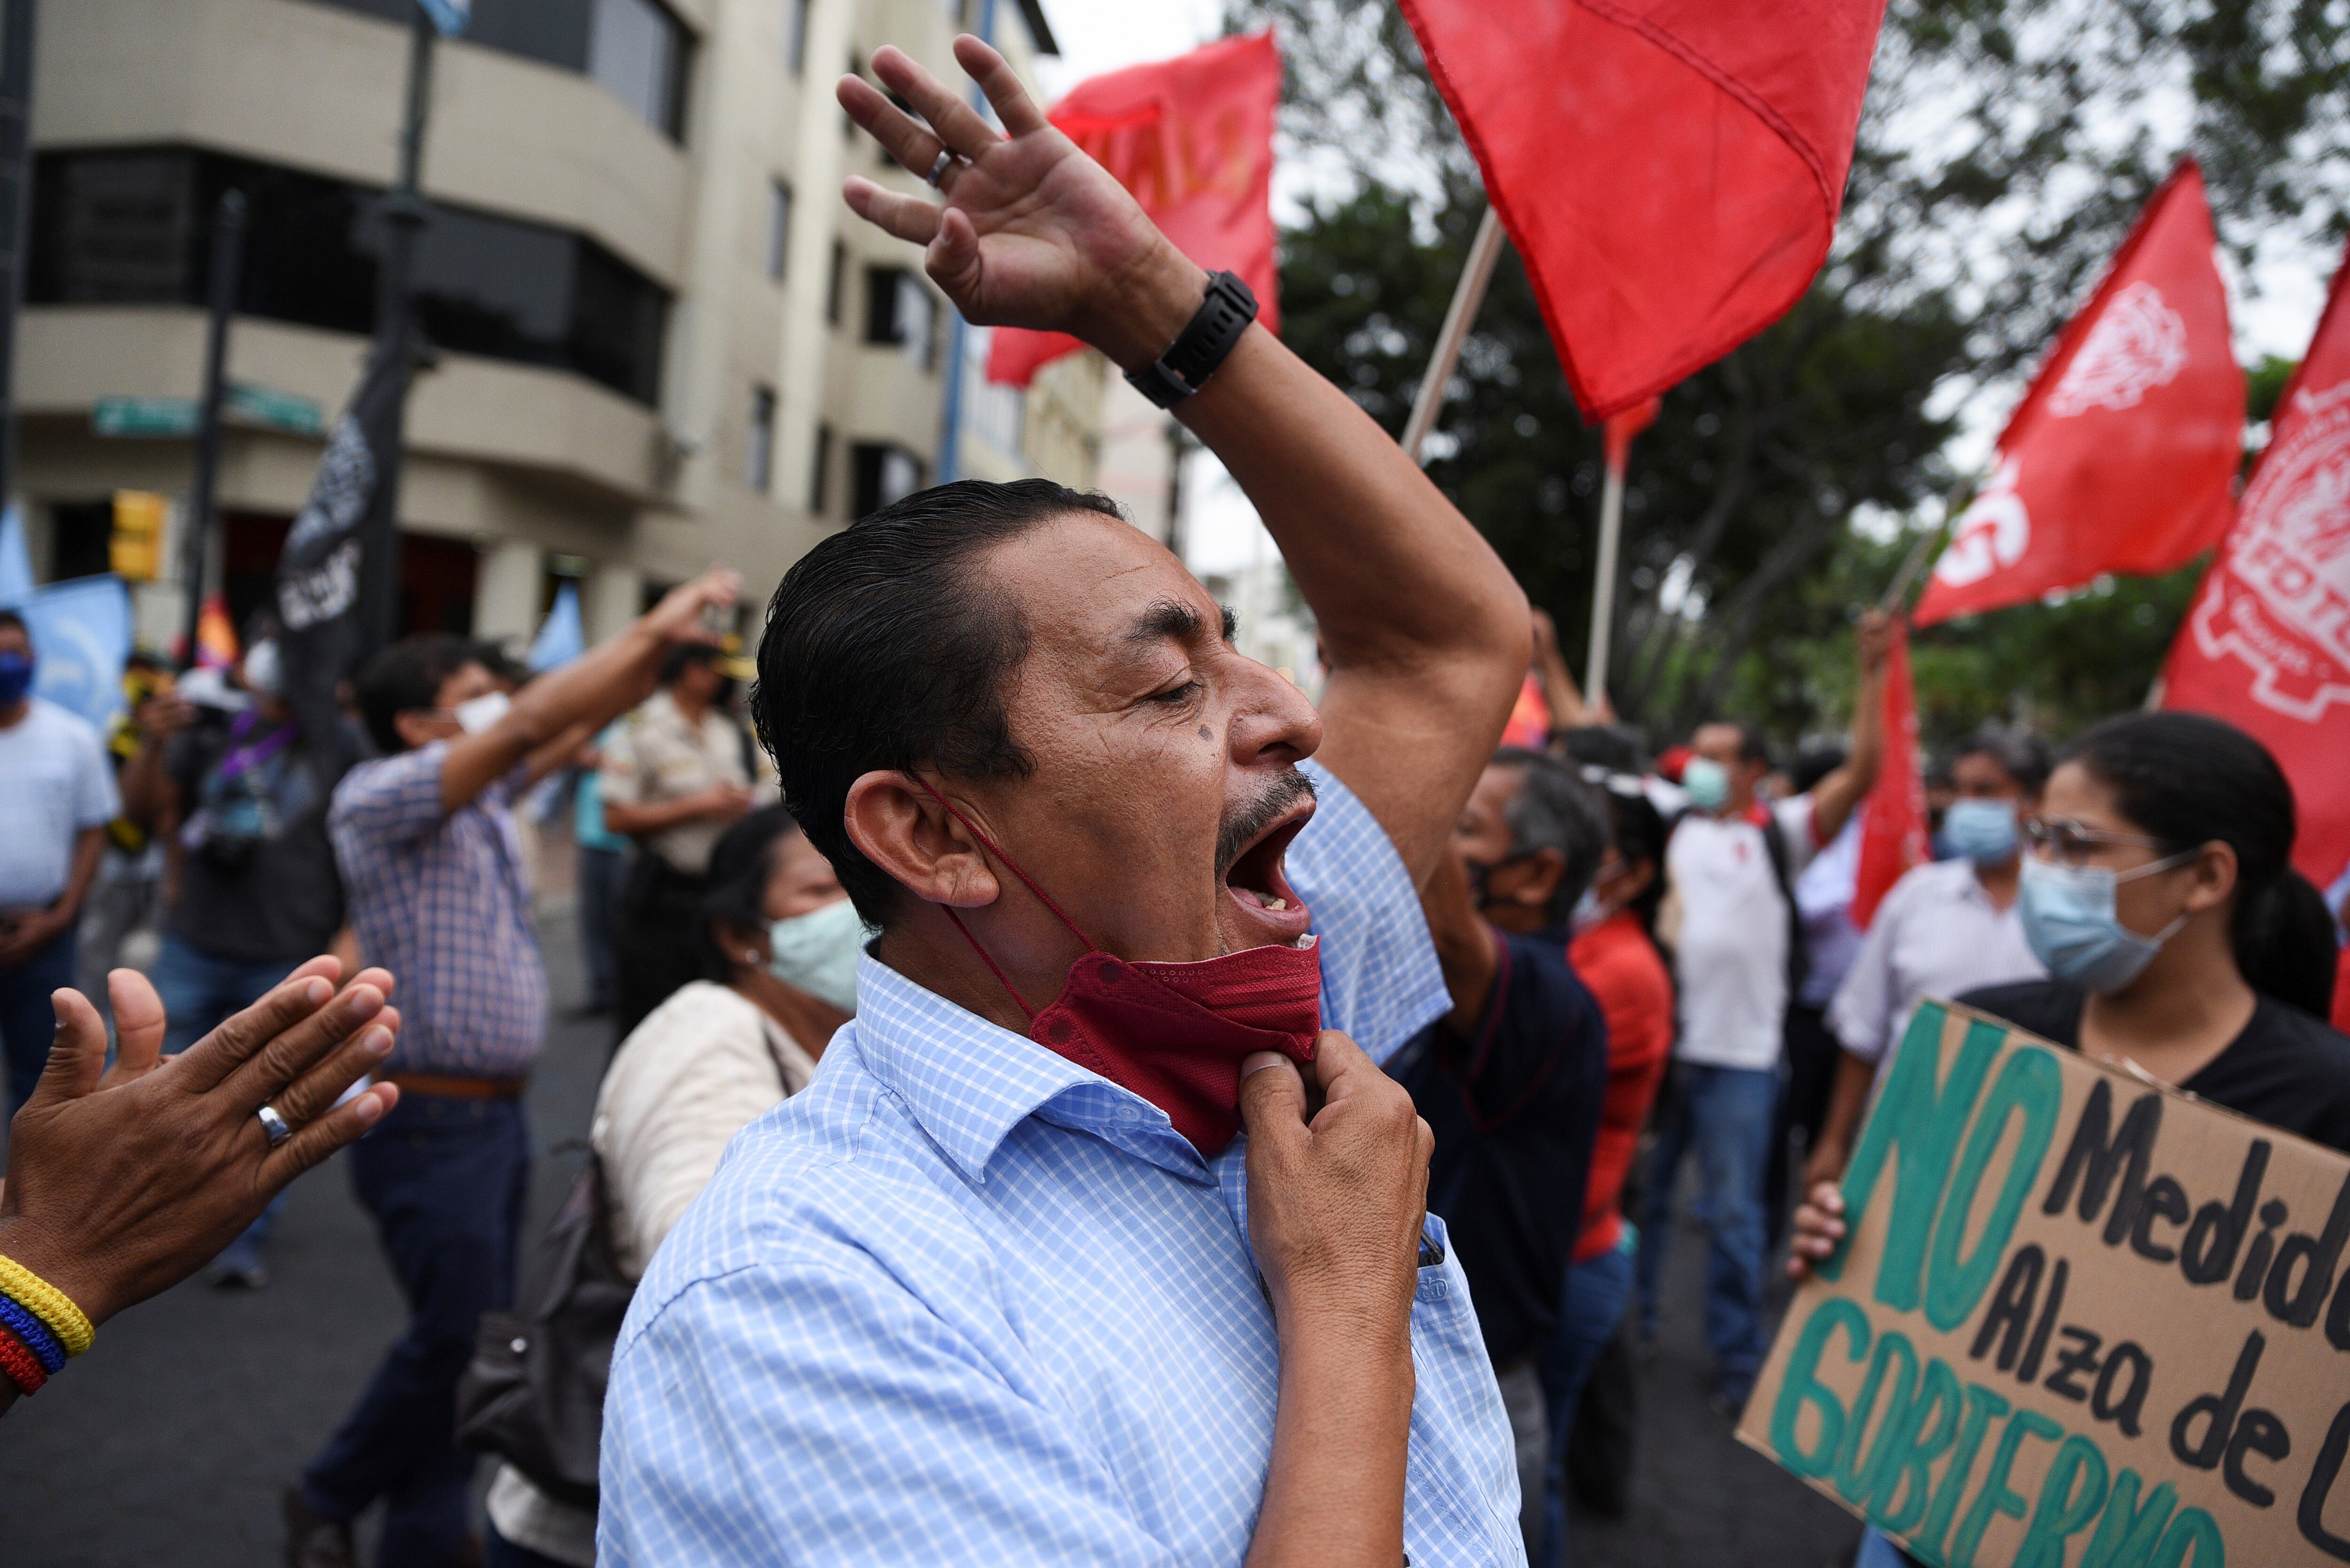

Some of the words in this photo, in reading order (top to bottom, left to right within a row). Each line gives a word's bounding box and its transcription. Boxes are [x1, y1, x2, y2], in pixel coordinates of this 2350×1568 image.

[1815, 1001, 2063, 1334] NO
[1968, 1243, 2154, 1439] Alza
[2169, 1328, 2291, 1508] de
